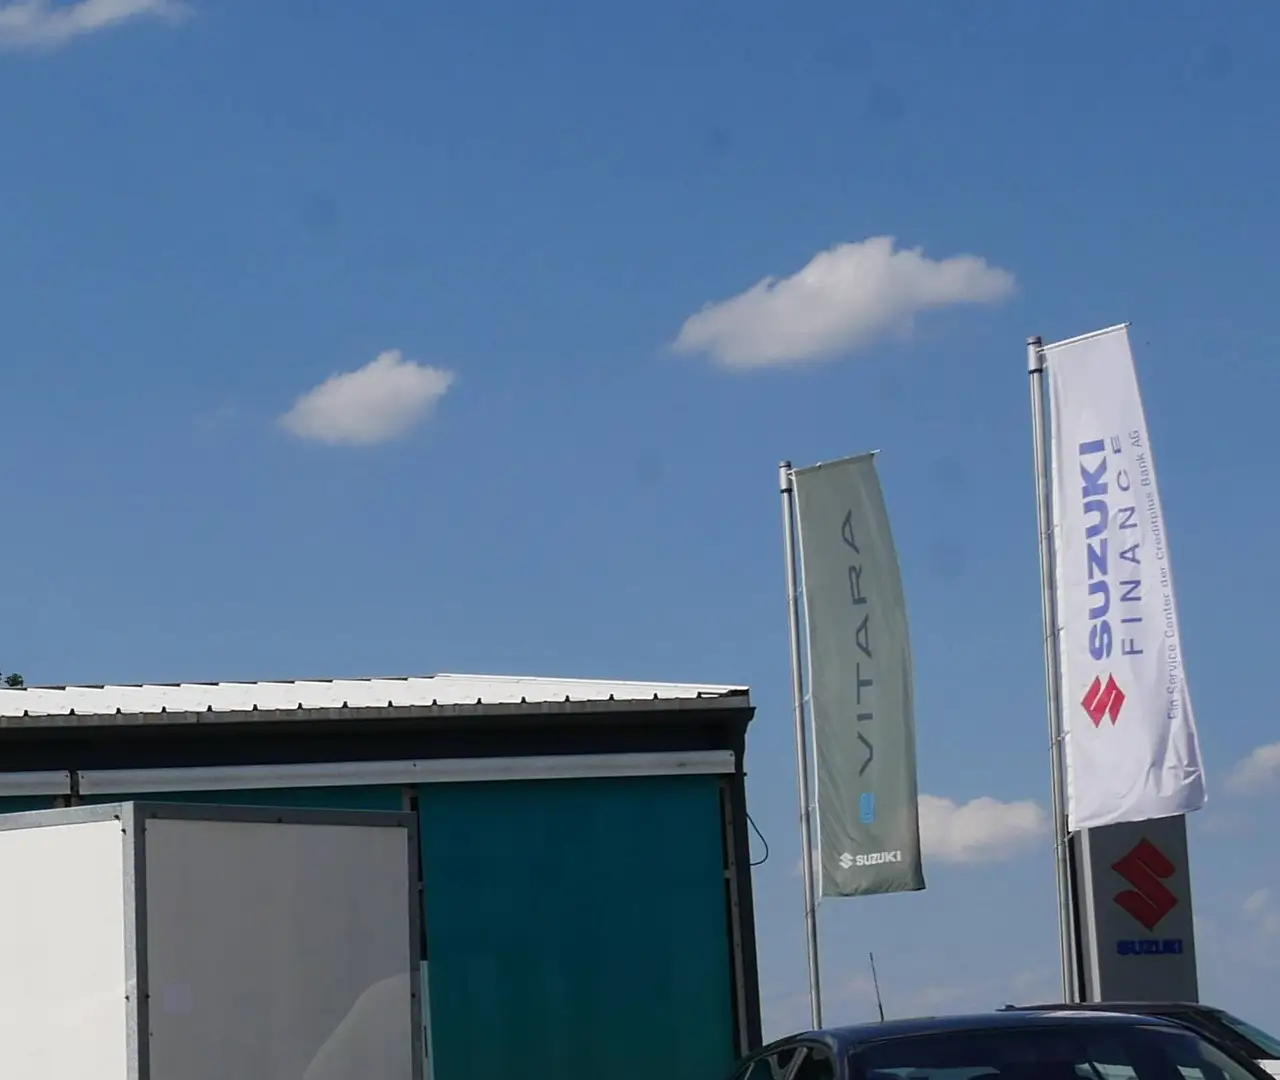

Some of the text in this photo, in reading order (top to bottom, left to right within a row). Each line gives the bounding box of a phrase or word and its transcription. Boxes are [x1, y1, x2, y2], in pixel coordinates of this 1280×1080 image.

[1128, 430, 1143, 448] AG
[1135, 452, 1151, 487] Bank
[1079, 439, 1113, 660] SUZUKI
[1110, 435, 1144, 656] FINANCE
[1162, 593, 1175, 639] Center
[841, 508, 874, 777] VITARA
[1166, 643, 1180, 695] Service
[855, 851, 902, 866] SUZUKI
